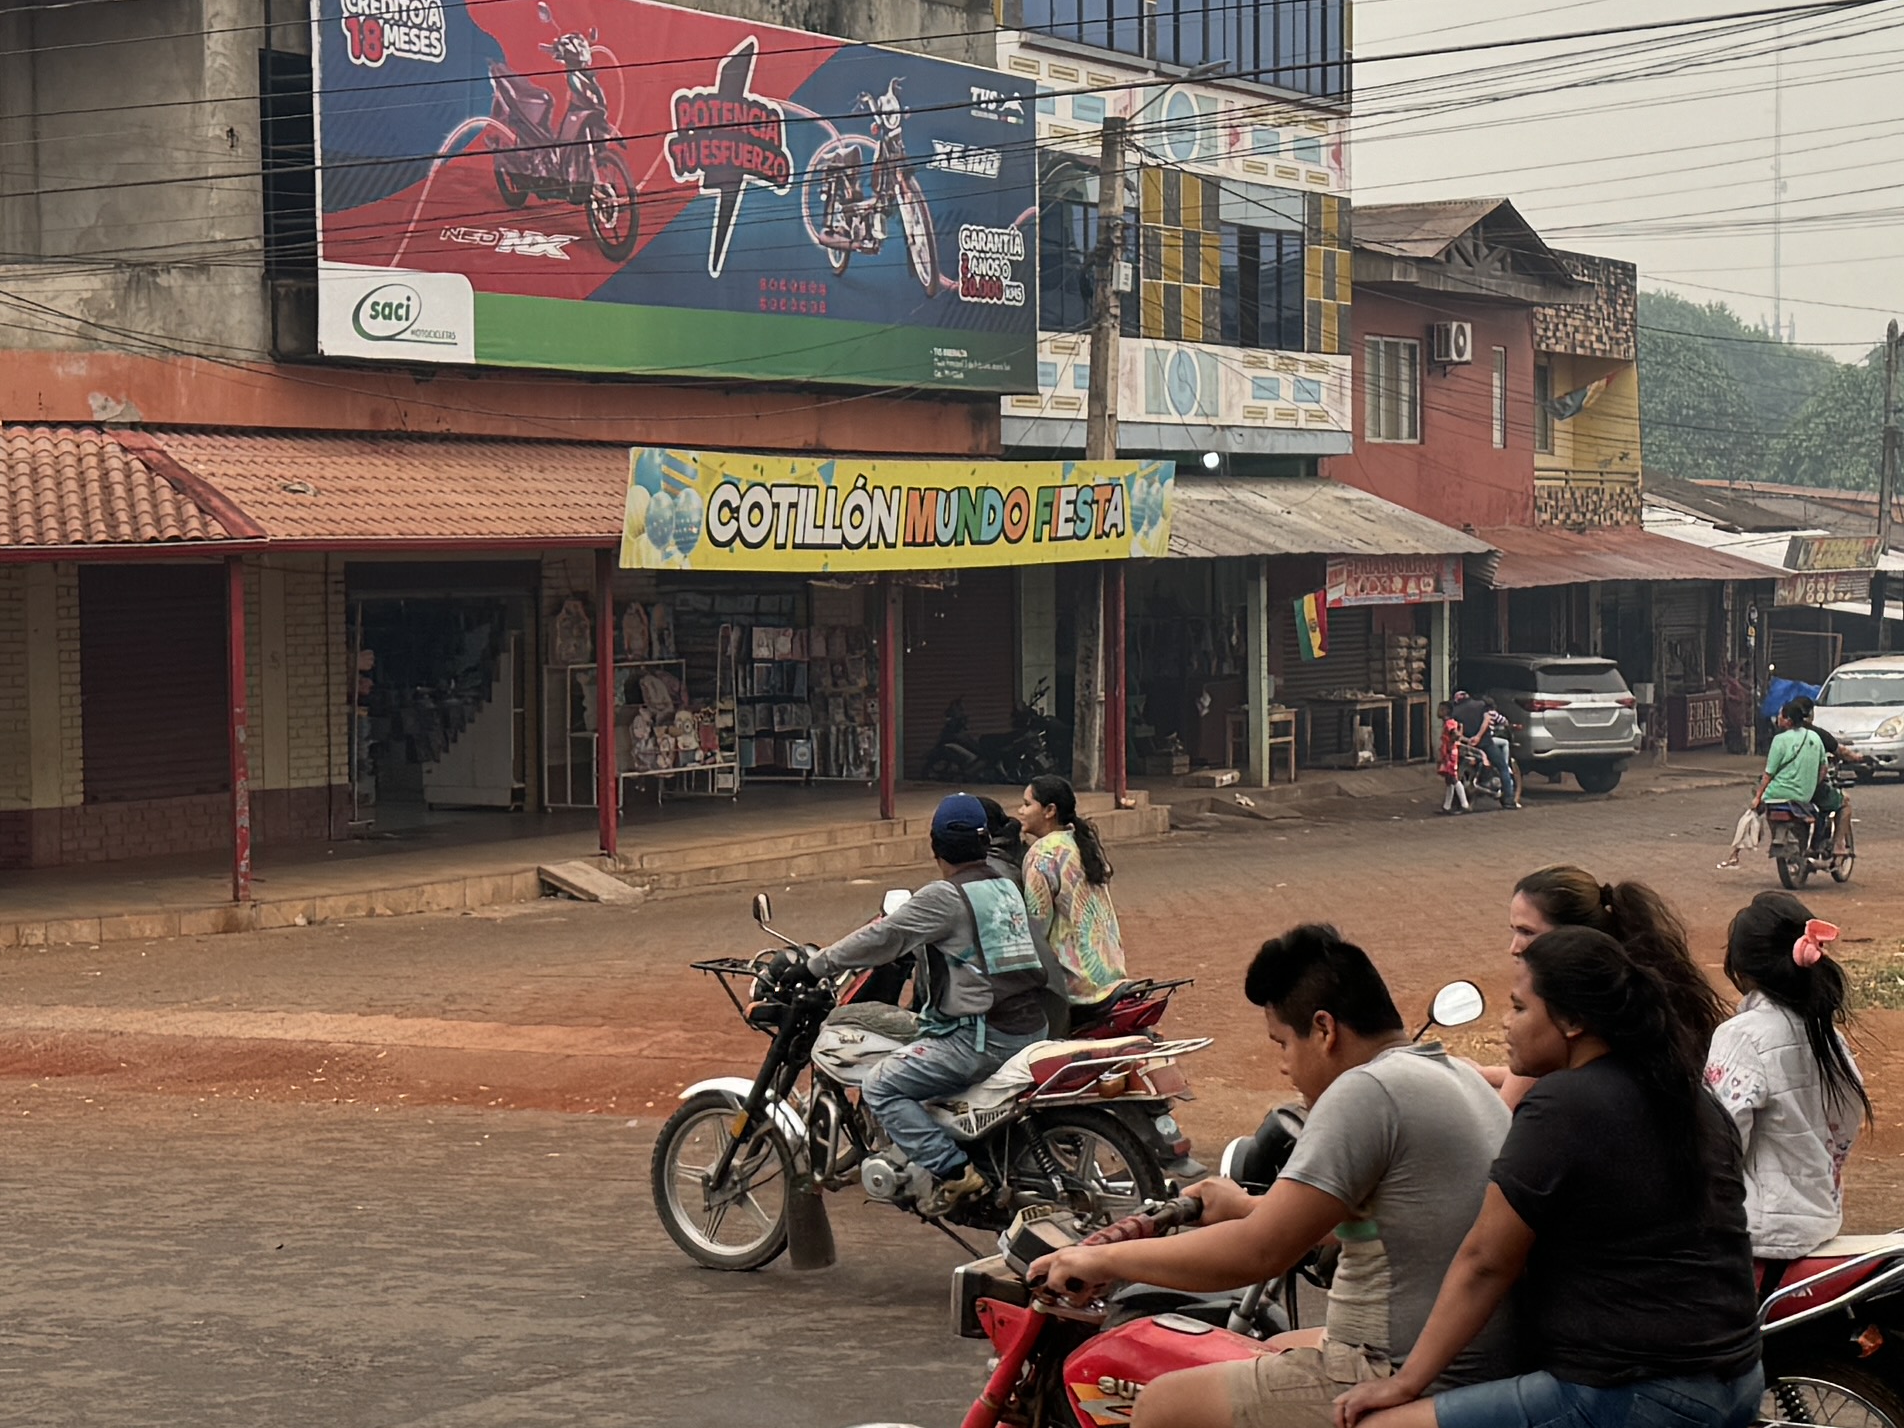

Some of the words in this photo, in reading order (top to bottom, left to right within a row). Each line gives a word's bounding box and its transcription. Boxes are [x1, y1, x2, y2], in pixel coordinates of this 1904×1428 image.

[345, 16, 384, 63] 18
[383, 23, 443, 58] MESES
[678, 100, 780, 146] POTENCIA
[672, 142, 698, 169] TU
[700, 139, 786, 184] ESFUERZO
[961, 227, 1022, 256] GARANTÍA
[369, 295, 412, 322] saci
[707, 474, 900, 550] COTILLÓN
[904, 486, 1030, 547] MUNDO
[1034, 483, 1125, 542] FIESTA
